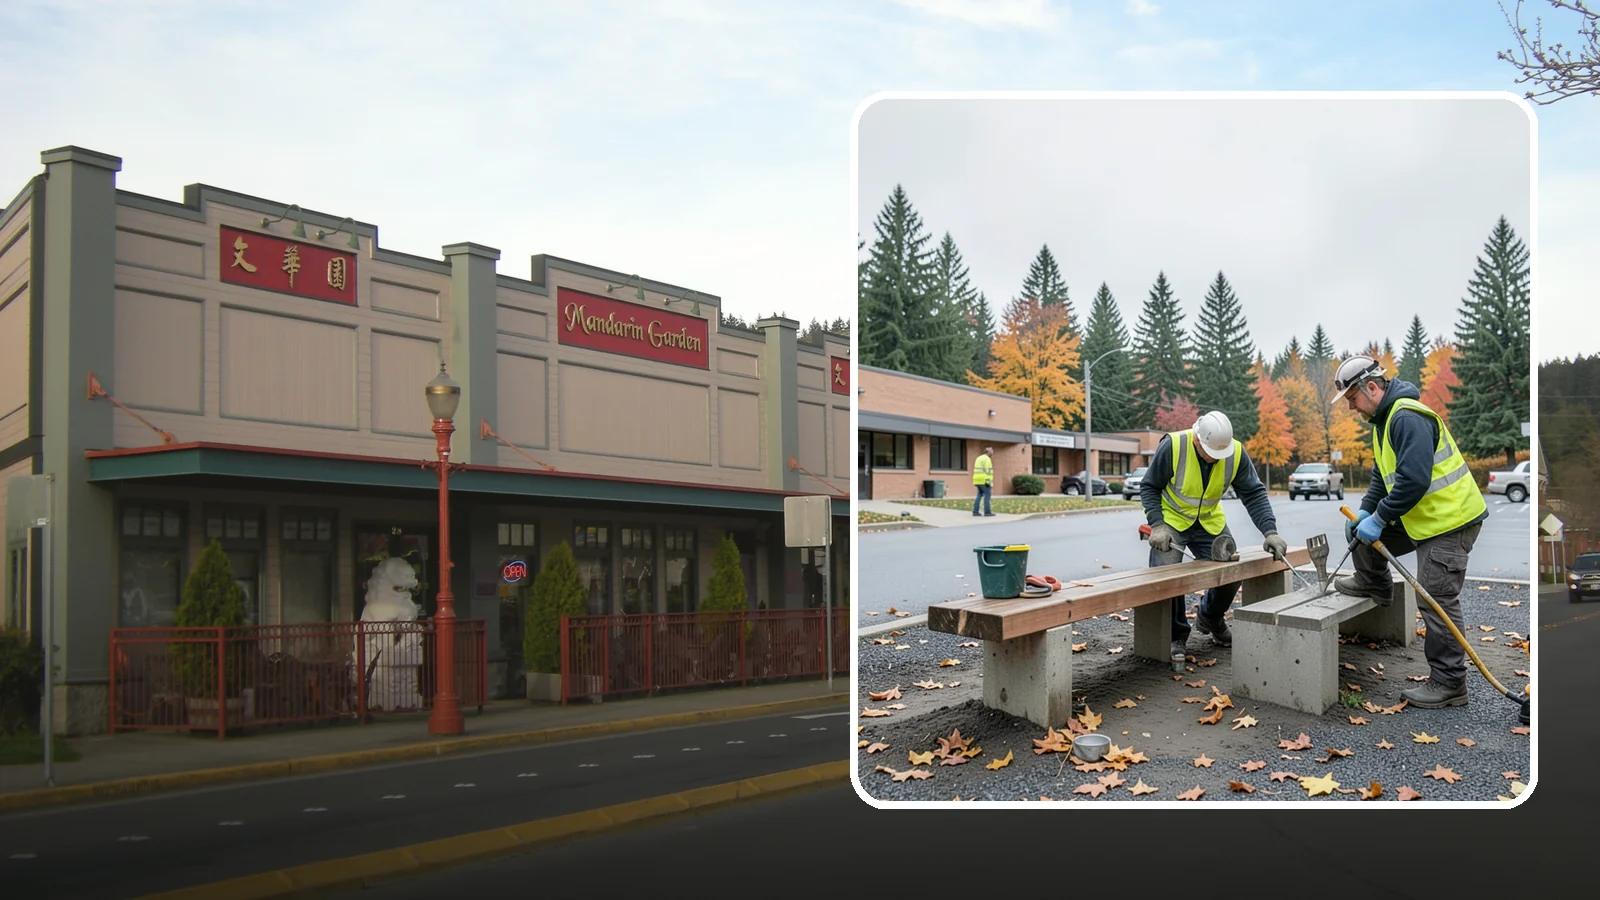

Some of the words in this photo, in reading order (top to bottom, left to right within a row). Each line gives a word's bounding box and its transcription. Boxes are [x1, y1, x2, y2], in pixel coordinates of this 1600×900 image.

[564, 302, 644, 341] Mandarin
[648, 320, 701, 352] Garden
[503, 565, 527, 578] OPEN
